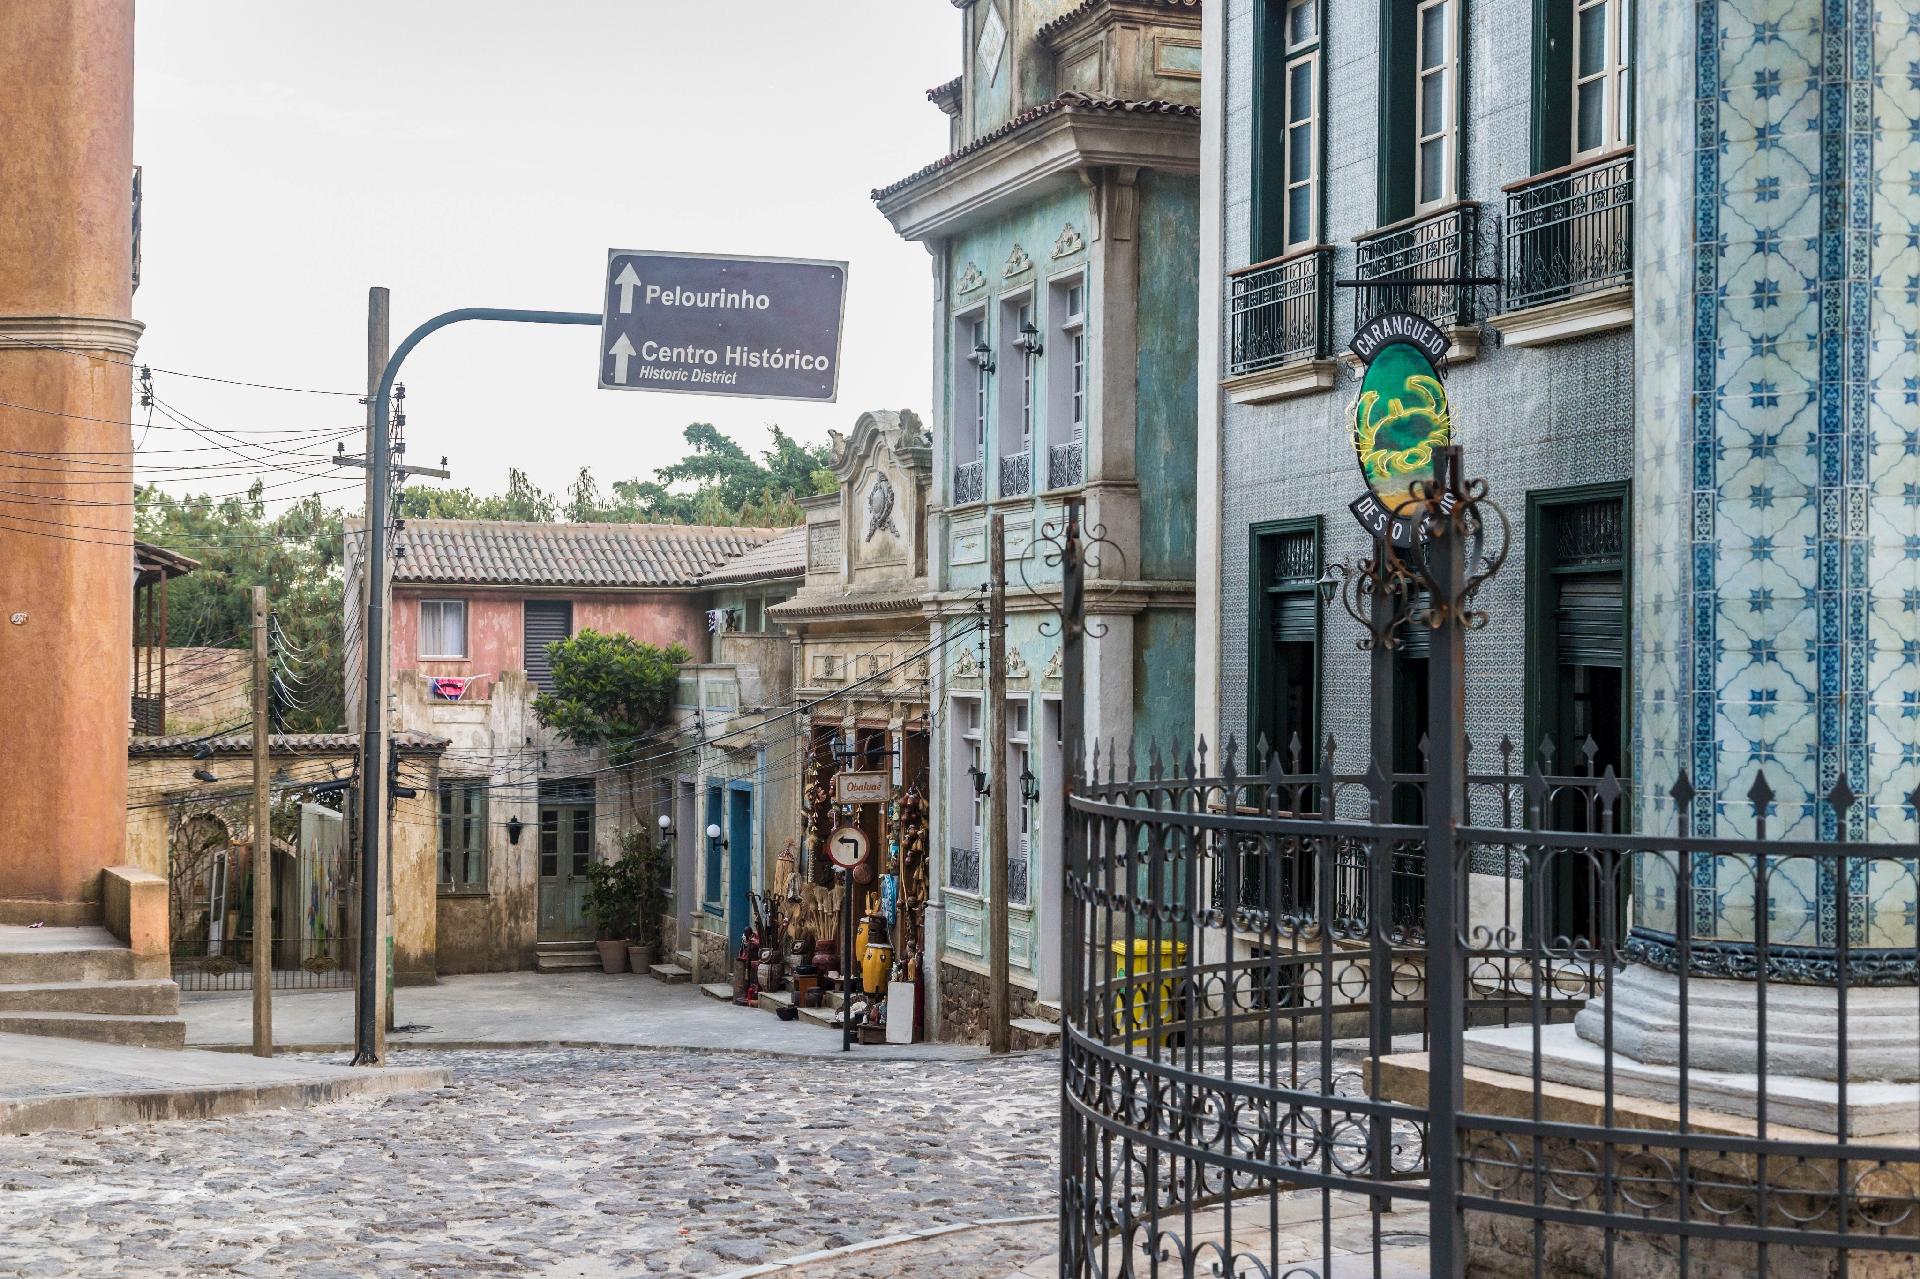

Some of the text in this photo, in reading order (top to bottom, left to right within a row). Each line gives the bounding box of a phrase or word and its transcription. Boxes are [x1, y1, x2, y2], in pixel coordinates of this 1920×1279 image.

[646, 285, 770, 310] Pelourinho
[1356, 315, 1445, 356] CARANGUEJO
[642, 341, 829, 371] Centro Histórico
[691, 368, 737, 385] District
[1373, 513, 1403, 540] SO
